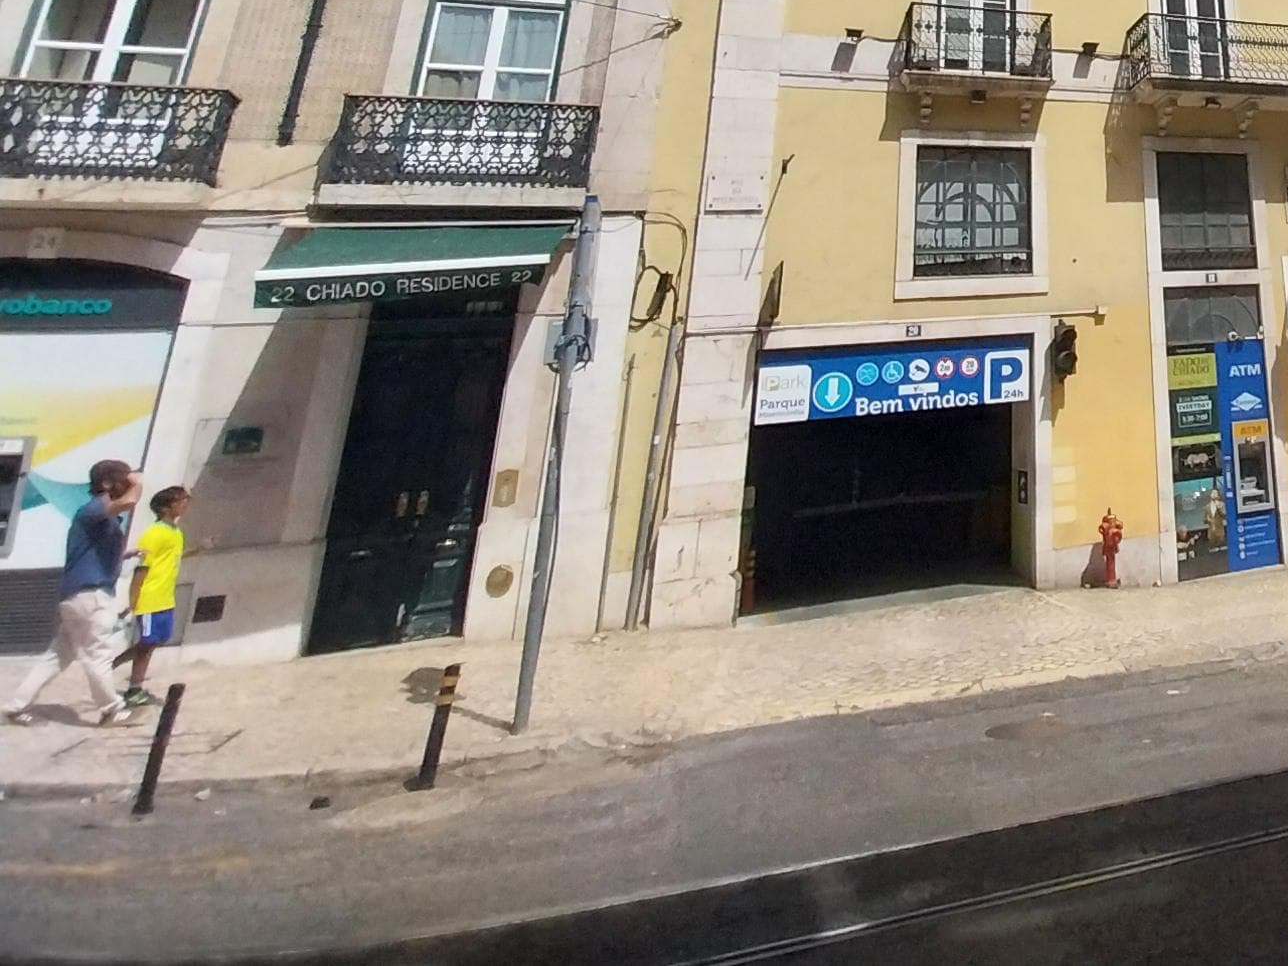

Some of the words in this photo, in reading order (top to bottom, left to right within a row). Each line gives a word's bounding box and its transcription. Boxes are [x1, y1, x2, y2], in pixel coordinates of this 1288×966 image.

[271, 286, 295, 303] 22
[306, 279, 386, 302] CHIADO
[396, 273, 501, 295] RESIDENCE
[511, 270, 532, 283] 22
[990, 357, 1023, 401] P
[1229, 363, 1262, 378] ATM
[760, 398, 806, 410] Parque
[855, 397, 904, 416] Bem
[908, 390, 979, 412] vindos
[1003, 390, 1024, 400] 24h
